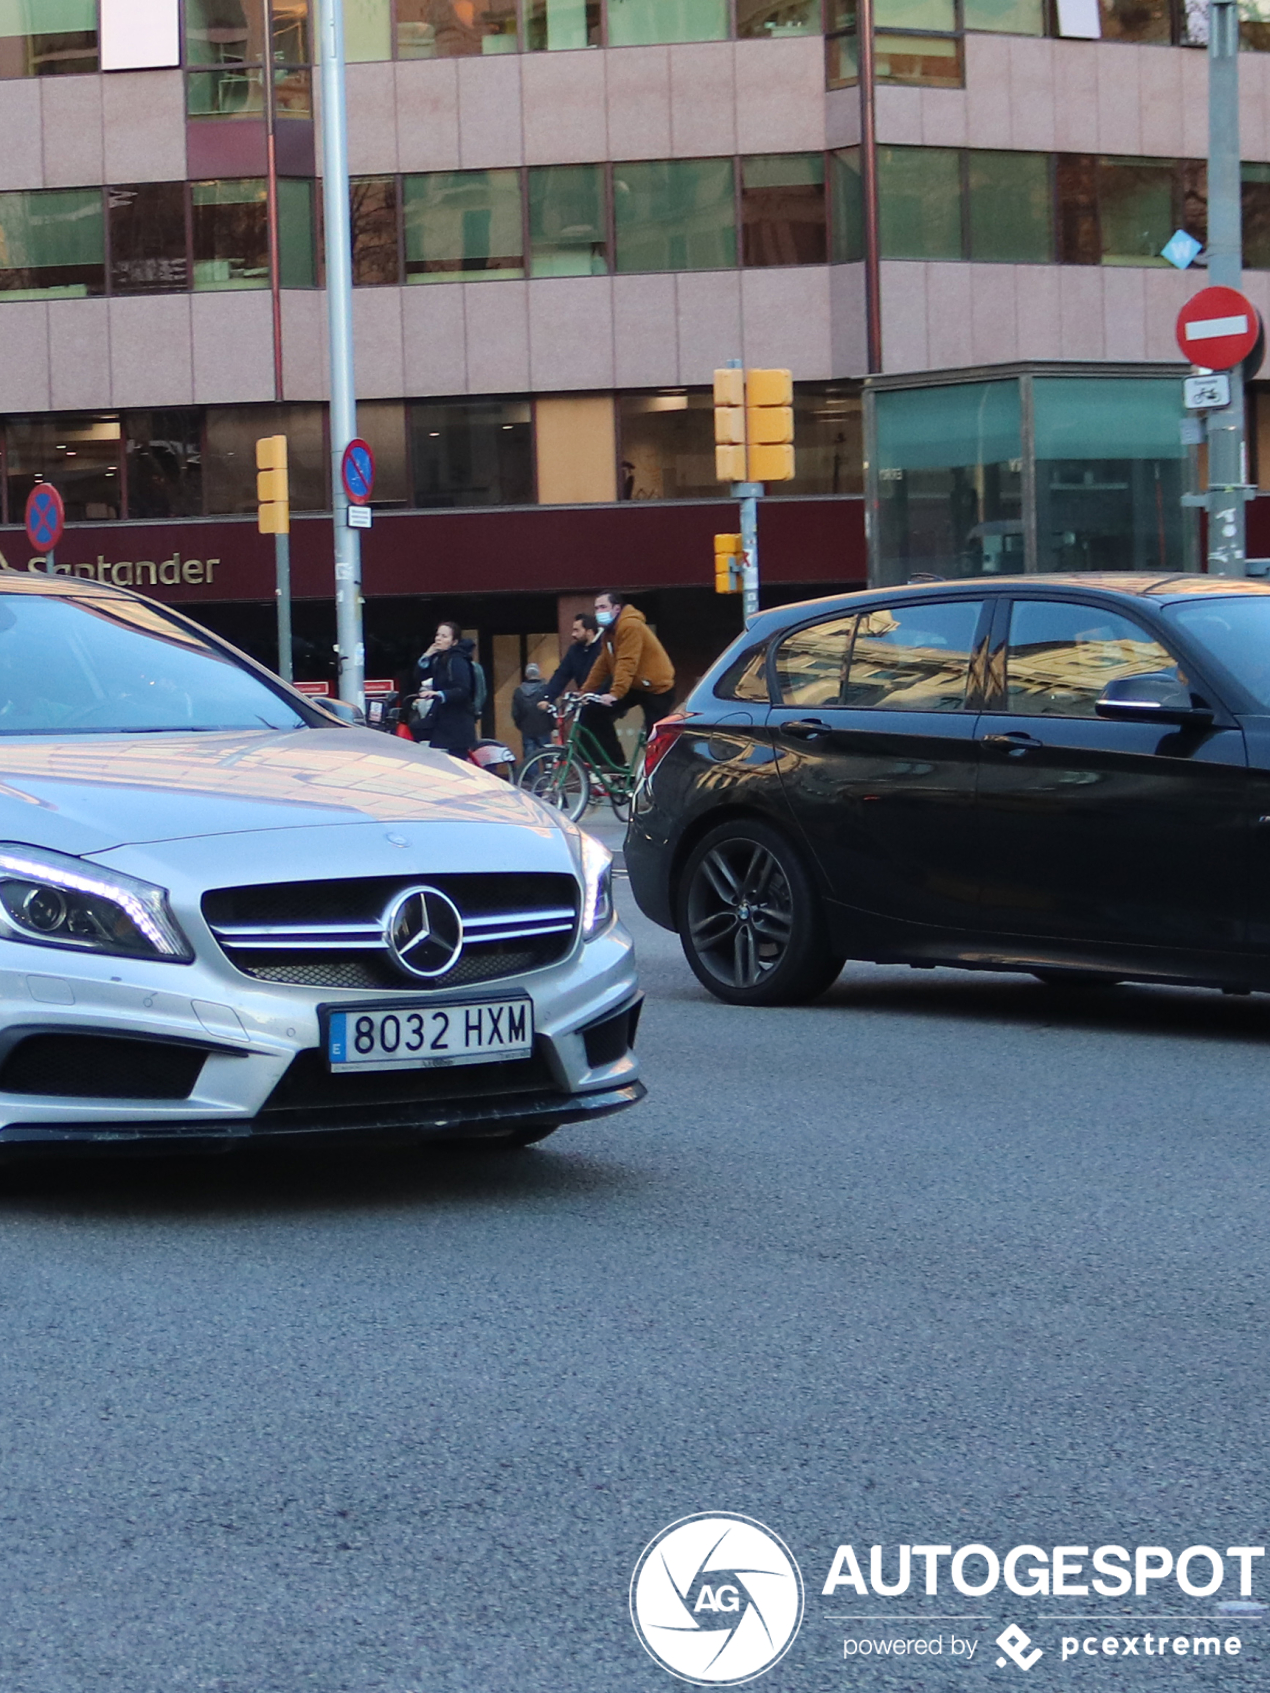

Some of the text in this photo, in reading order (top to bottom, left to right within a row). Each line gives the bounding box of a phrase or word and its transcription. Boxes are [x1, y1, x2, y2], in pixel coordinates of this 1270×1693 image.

[1172, 240, 1192, 259] W
[354, 1005, 526, 1054] 8032 HXM
[332, 1044, 341, 1055] E
